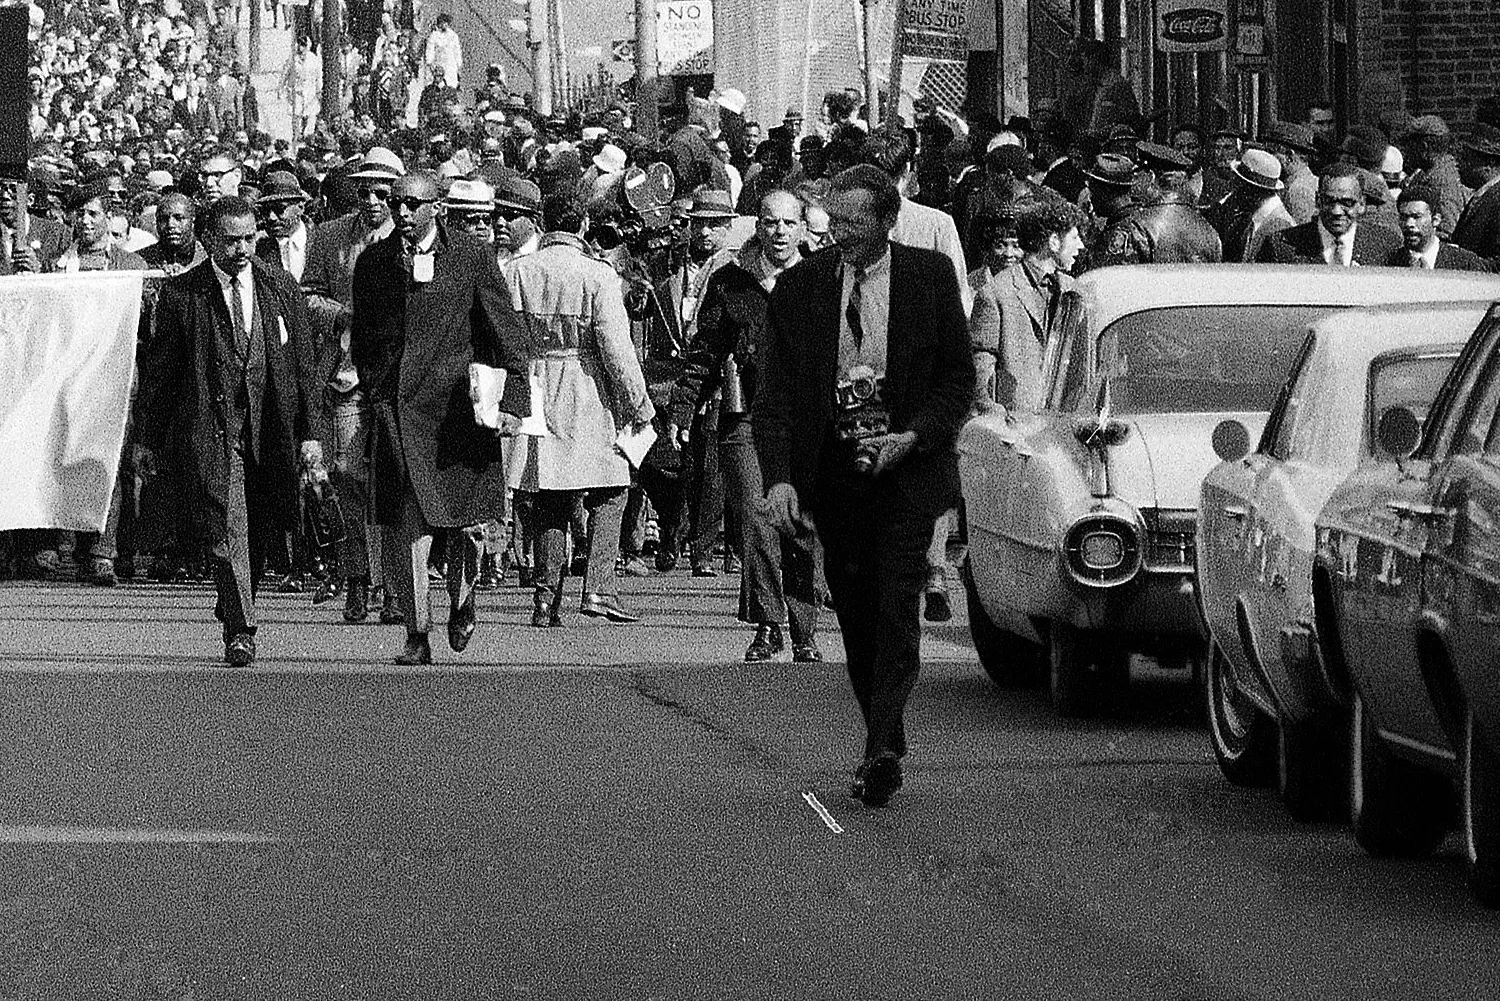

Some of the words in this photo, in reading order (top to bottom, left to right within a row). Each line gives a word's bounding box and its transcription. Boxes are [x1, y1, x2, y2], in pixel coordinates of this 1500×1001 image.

[668, 4, 702, 20] NO
[940, 0, 967, 14] TIME
[908, 10, 933, 26] BUS
[934, 12, 966, 29] STOP
